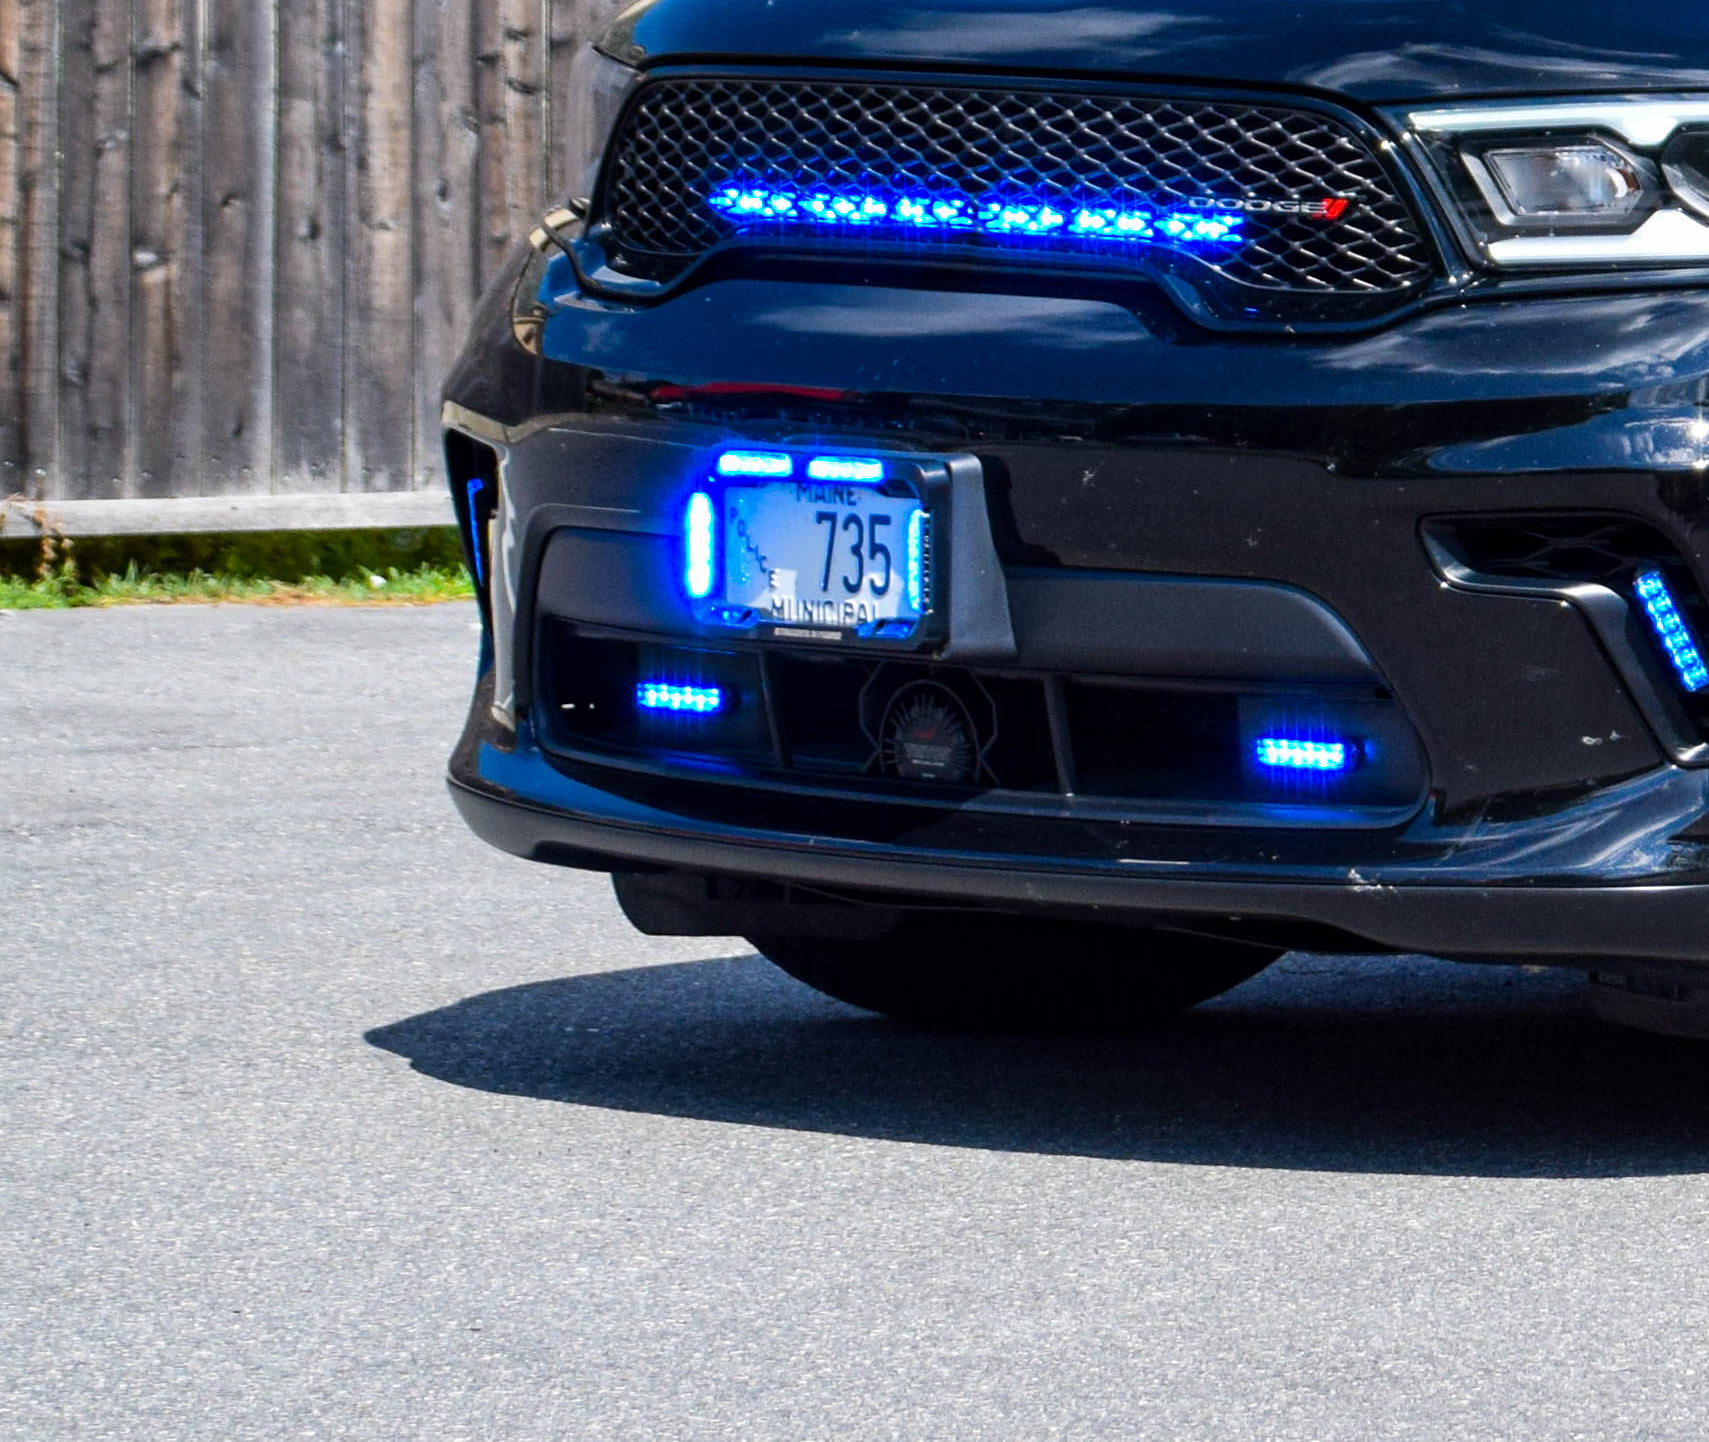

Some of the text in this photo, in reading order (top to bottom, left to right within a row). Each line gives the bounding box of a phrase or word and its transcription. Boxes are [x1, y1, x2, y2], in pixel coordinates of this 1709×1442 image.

[1189, 197, 1328, 213] DODGE
[796, 482, 858, 506] MAINE
[815, 510, 892, 596] 735
[771, 595, 880, 626] MUNICIPAL
